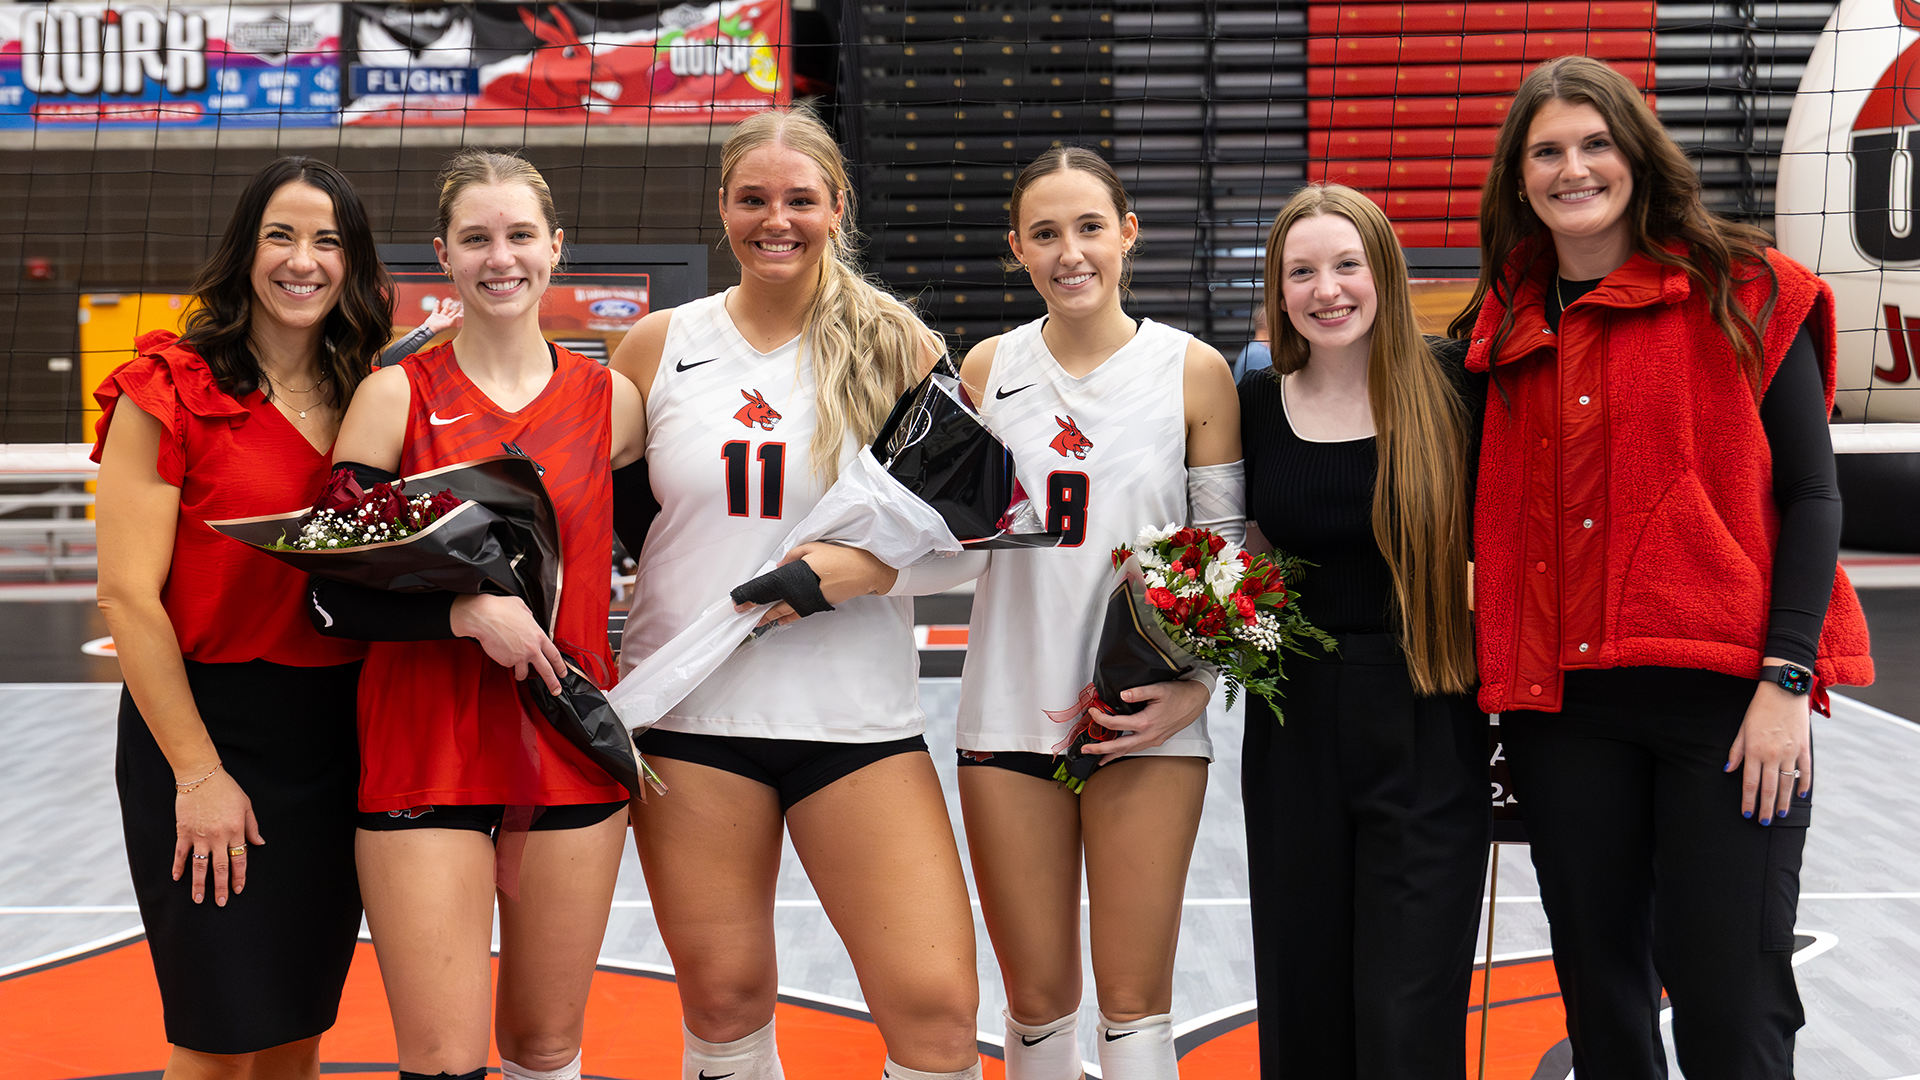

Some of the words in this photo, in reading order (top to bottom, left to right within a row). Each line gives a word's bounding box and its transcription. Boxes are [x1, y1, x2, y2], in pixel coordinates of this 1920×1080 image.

[367, 69, 466, 93] FLIGHT
[721, 440, 786, 520] 11
[1045, 470, 1090, 548] 8
